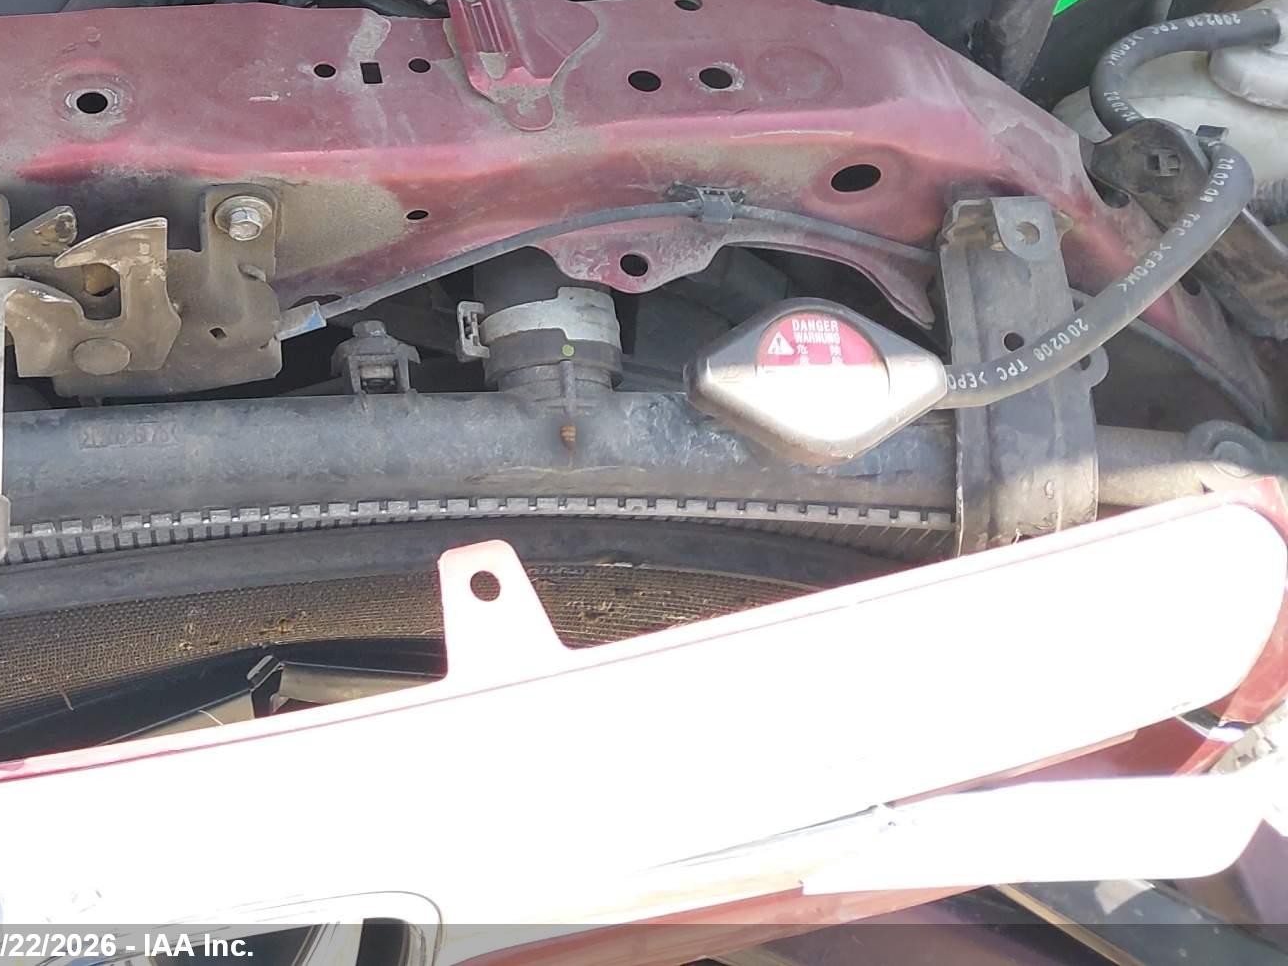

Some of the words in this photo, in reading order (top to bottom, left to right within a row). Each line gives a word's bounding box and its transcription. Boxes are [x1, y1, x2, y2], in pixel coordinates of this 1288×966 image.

[1170, 212, 1201, 236] TPC
[791, 319, 840, 332] DANGER
[996, 357, 1029, 382] TPC
